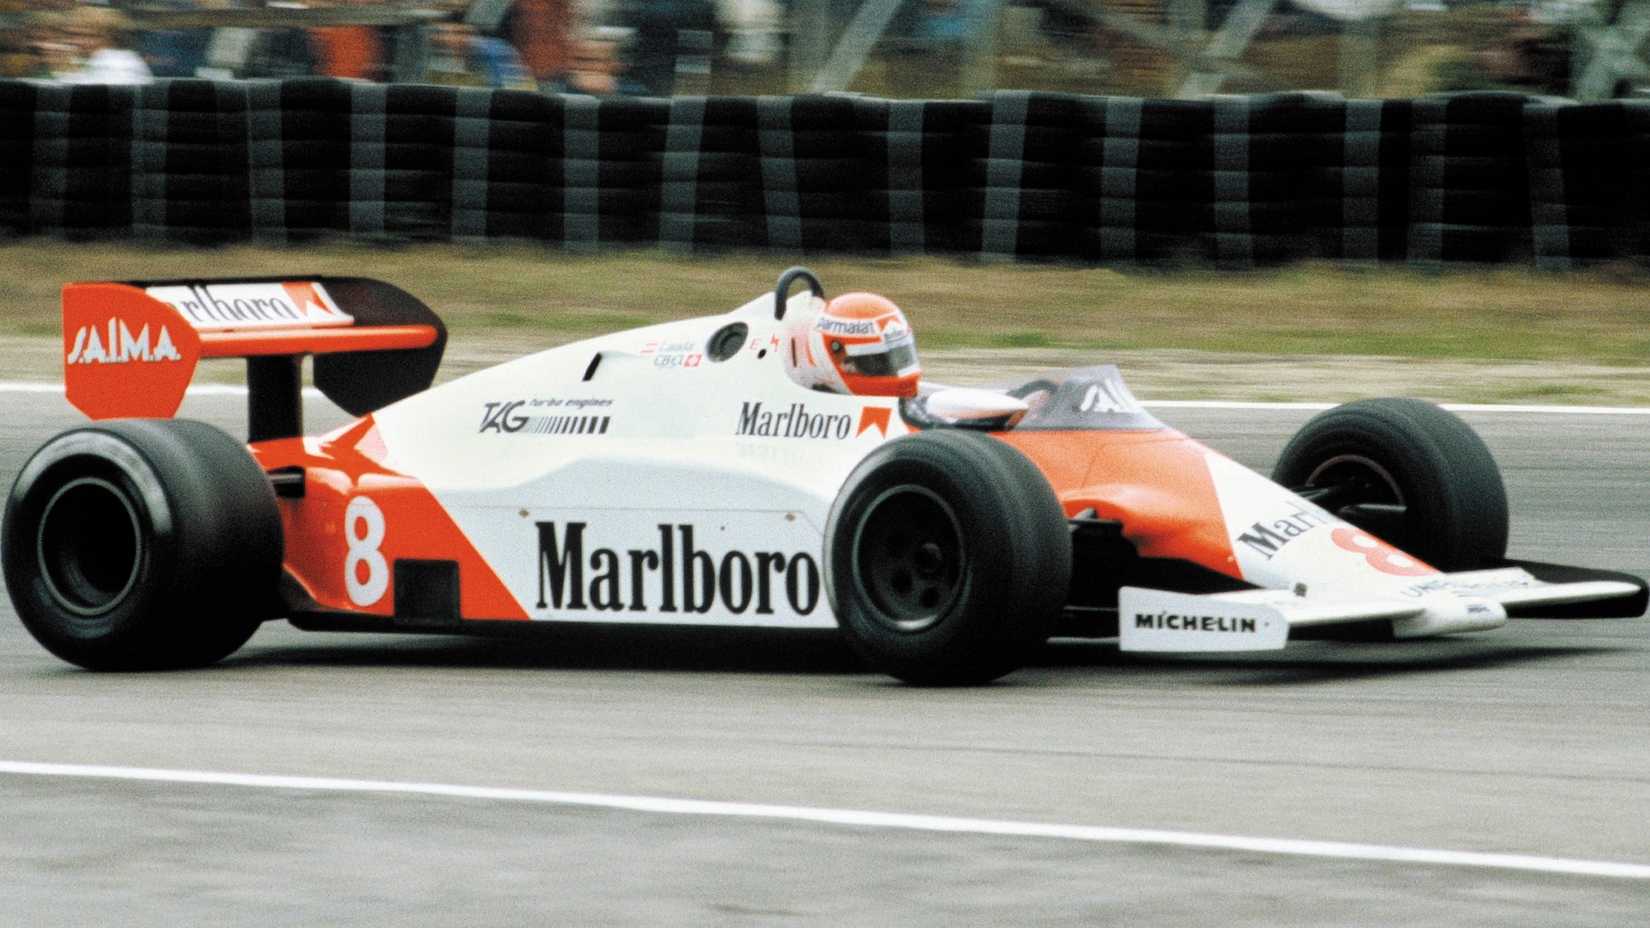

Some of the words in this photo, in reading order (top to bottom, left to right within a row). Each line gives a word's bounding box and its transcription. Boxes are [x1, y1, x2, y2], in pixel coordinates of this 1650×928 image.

[182, 285, 300, 323] rlboro
[480, 399, 529, 434] TAG
[736, 401, 852, 440] Marlboro
[345, 496, 389, 607] 8
[535, 521, 821, 616] Marlboro
[1135, 613, 1256, 633] MICHELIN
